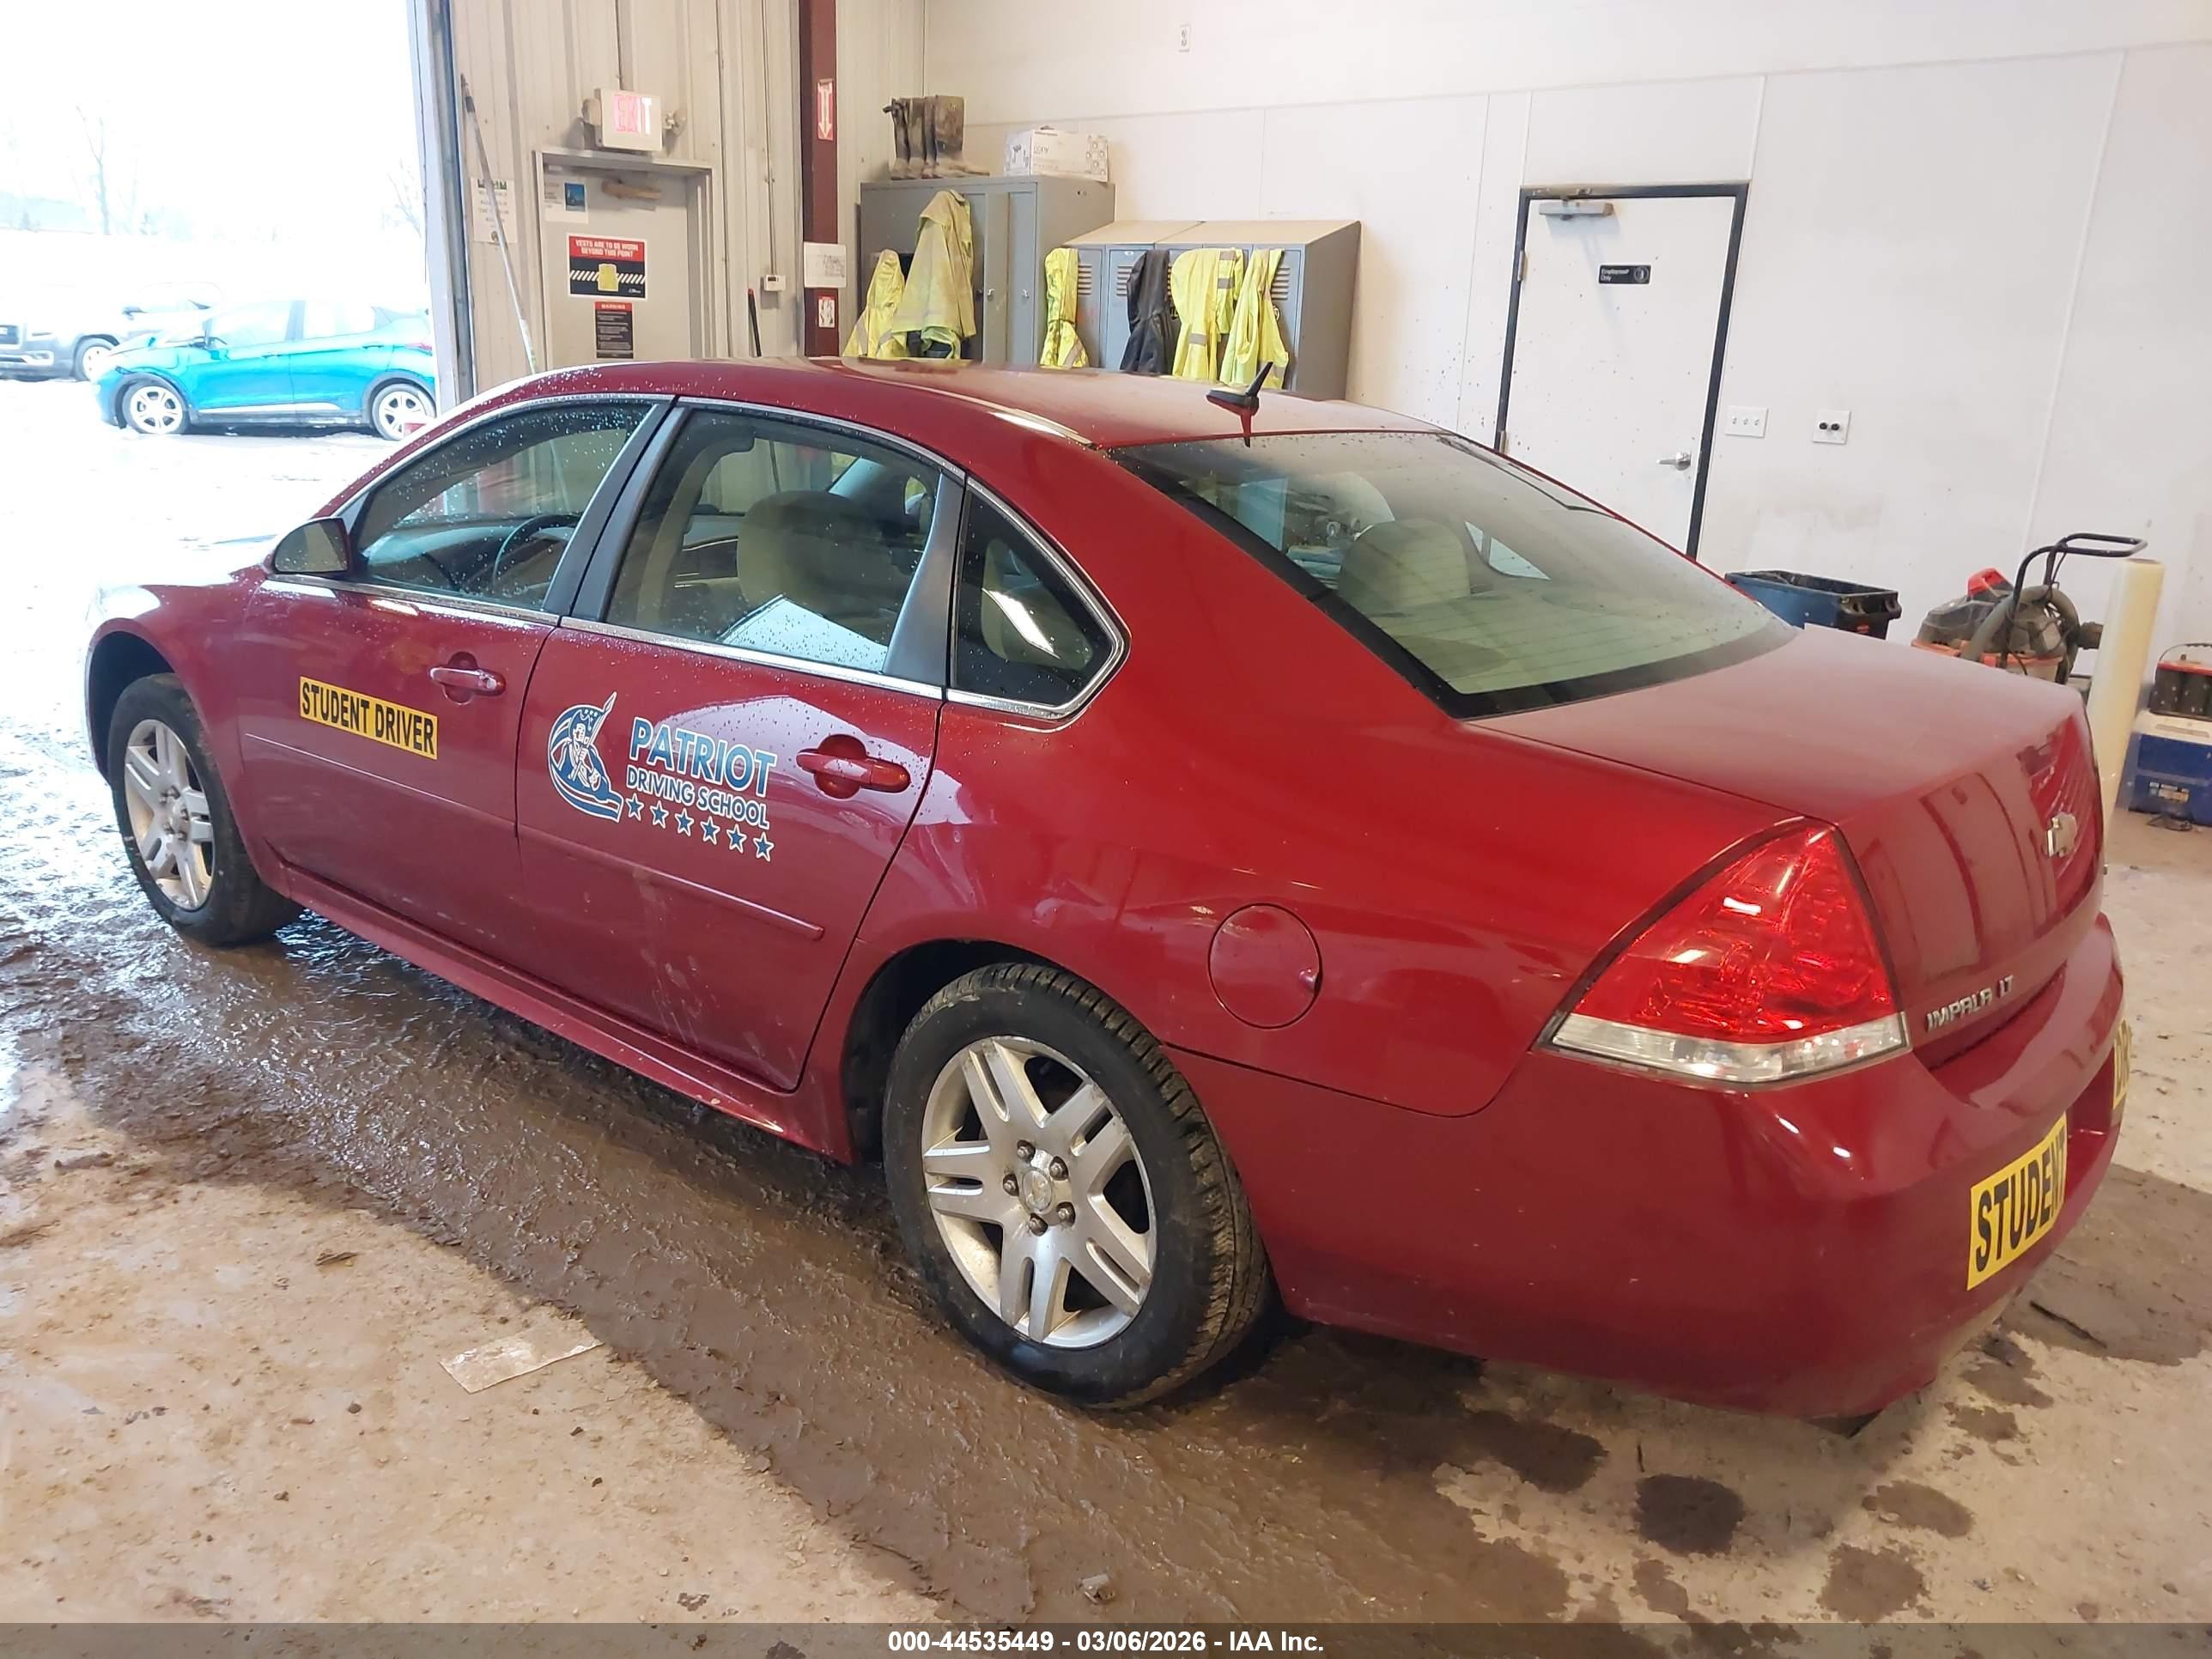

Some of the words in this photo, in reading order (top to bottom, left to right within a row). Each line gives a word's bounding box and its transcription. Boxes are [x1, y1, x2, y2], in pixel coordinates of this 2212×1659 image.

[613, 94, 652, 135] EXIT
[302, 682, 369, 734] STUDENT
[375, 703, 434, 755] DRIVER
[629, 716, 778, 799] PATRIOT
[626, 763, 696, 807] DRIVING
[696, 786, 770, 830] SCHOOL
[1926, 988, 1992, 1032] IMPALA
[1997, 974, 2014, 999] LT
[1975, 1125, 2065, 1273] STUDENT
